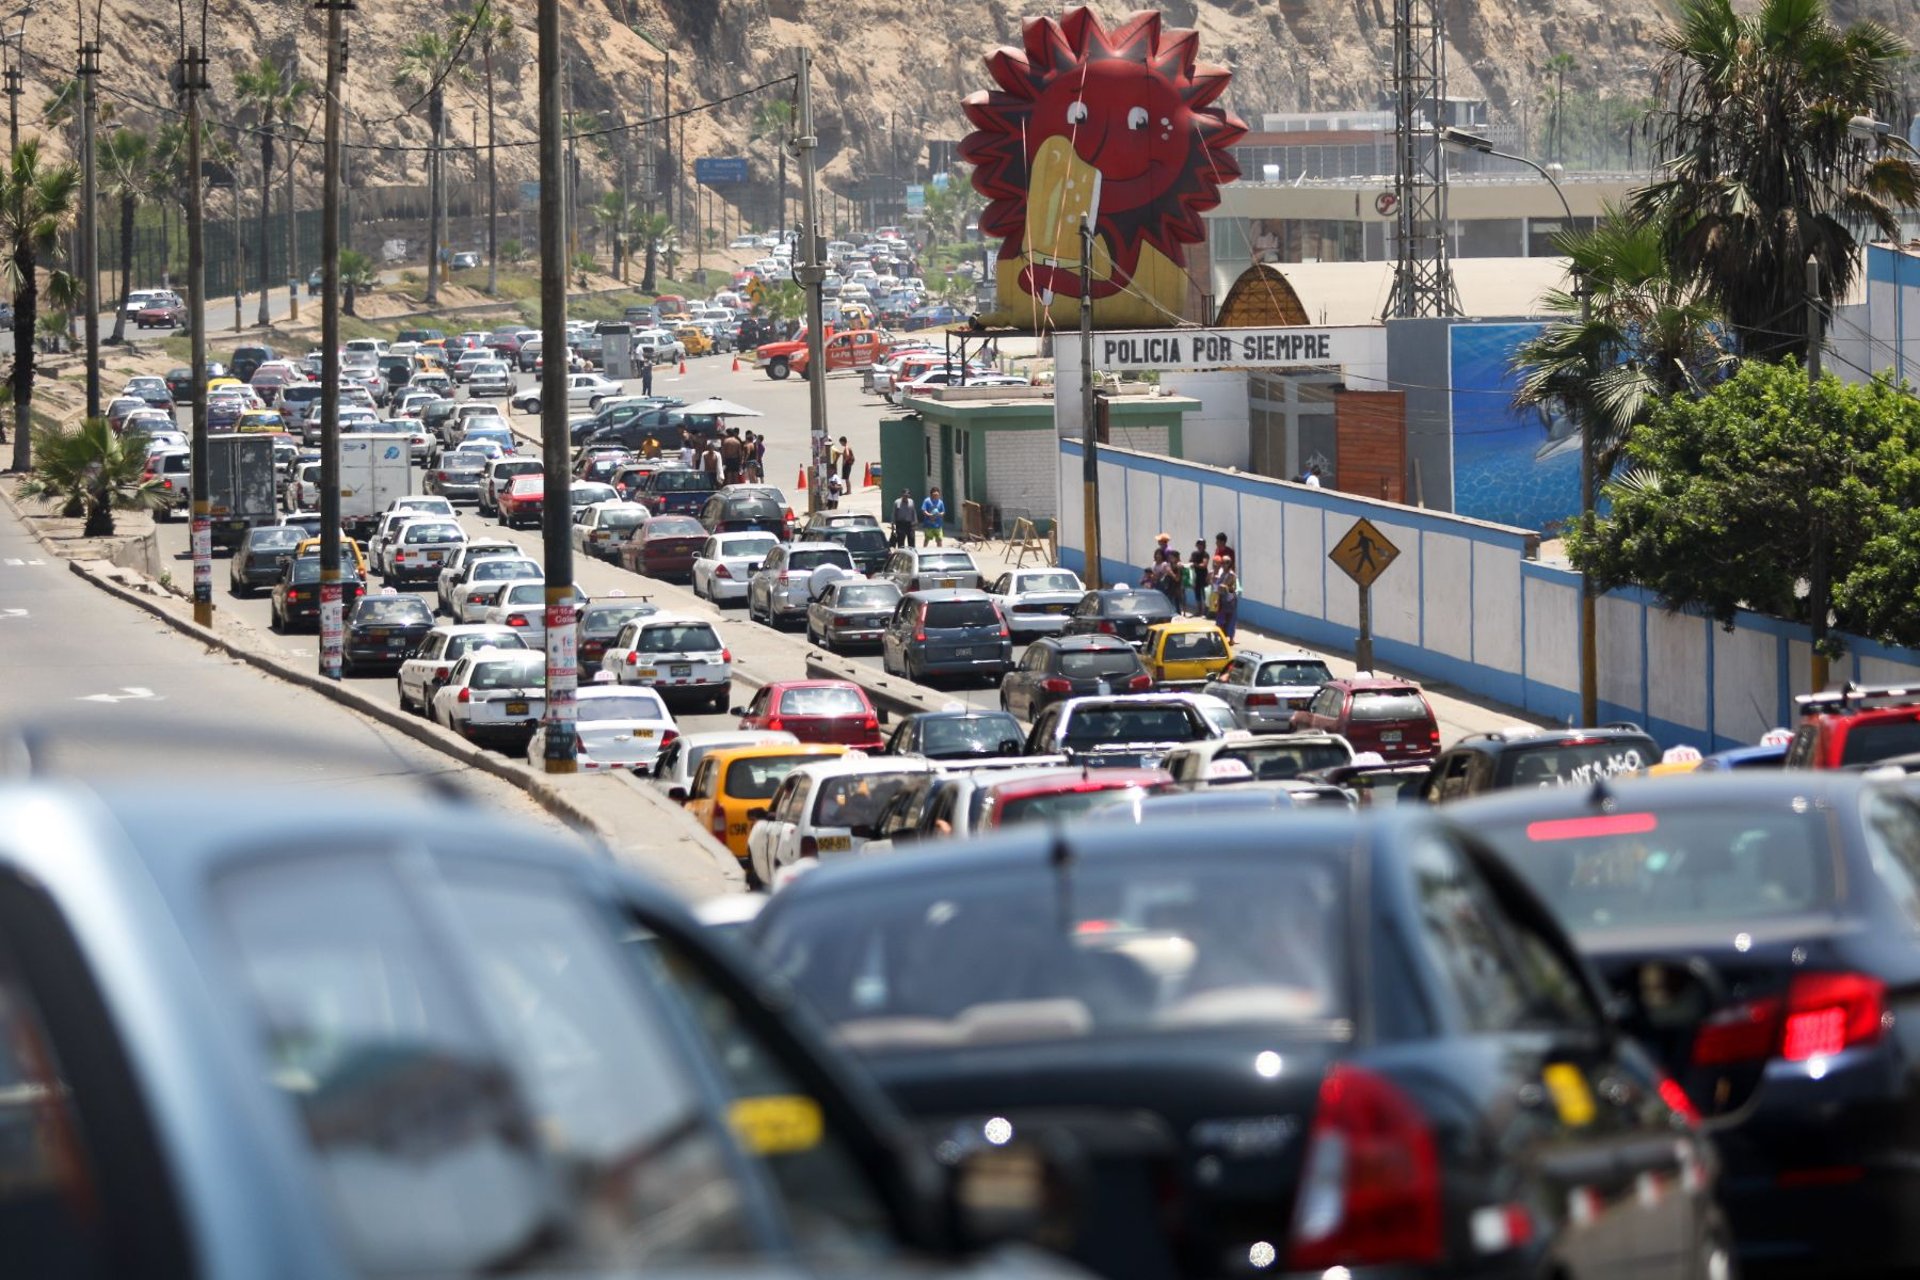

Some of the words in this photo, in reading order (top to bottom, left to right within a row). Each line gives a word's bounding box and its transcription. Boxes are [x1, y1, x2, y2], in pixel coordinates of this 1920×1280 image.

[1104, 337, 1181, 364] POLICIA
[1193, 336, 1231, 362] POR
[1243, 334, 1330, 360] SIEMPRE
